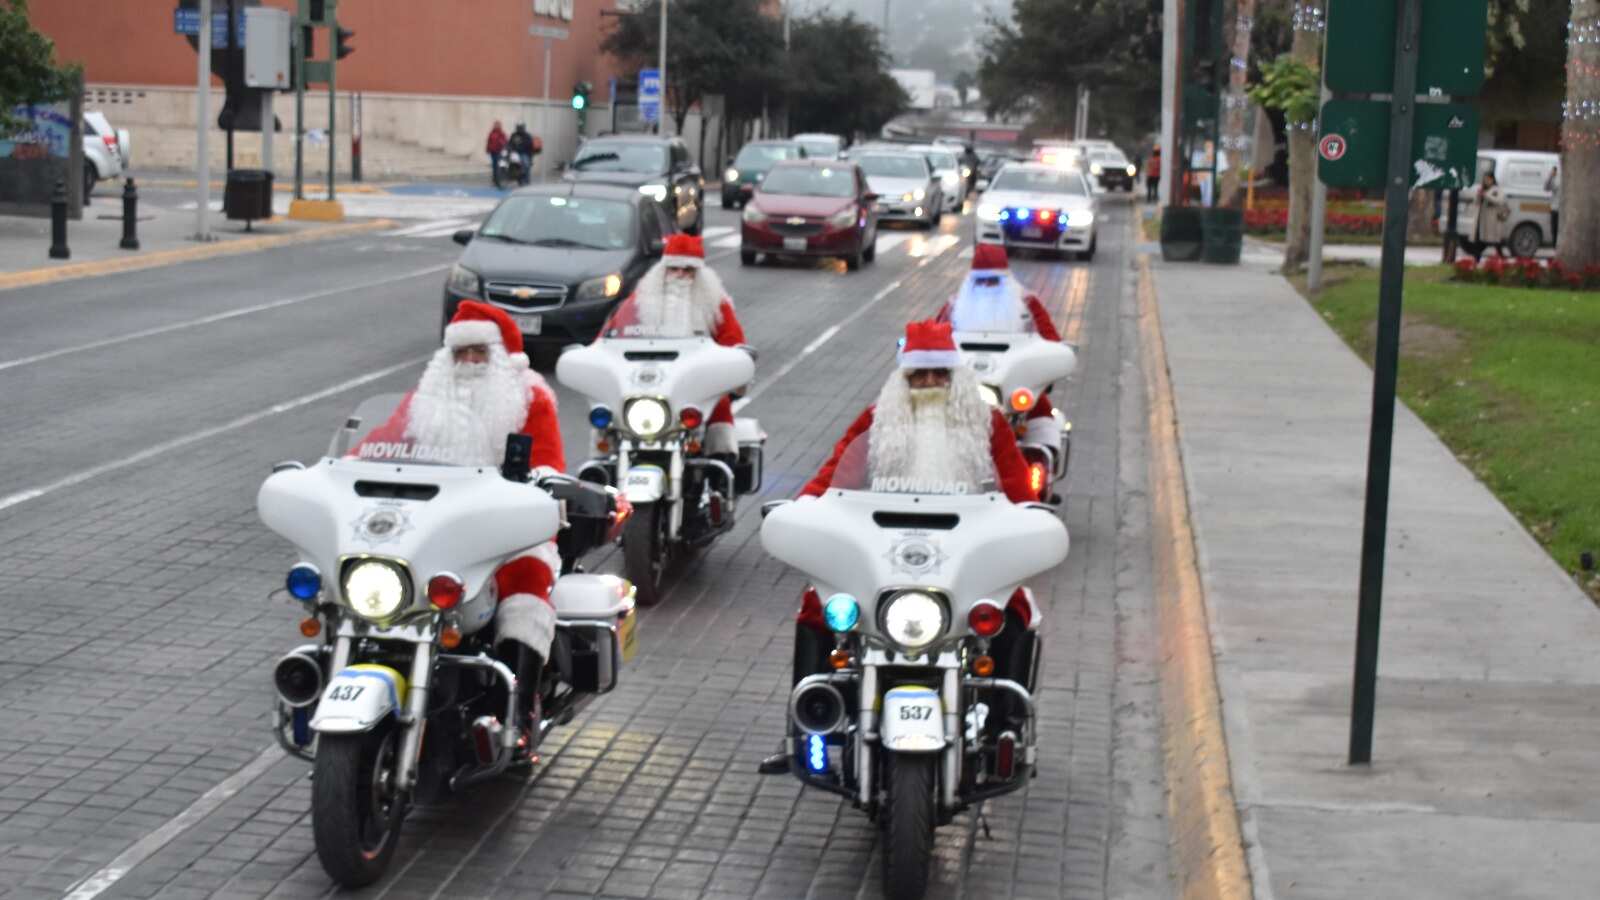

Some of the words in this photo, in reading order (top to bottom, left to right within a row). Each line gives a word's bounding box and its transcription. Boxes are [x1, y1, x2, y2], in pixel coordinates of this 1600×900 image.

[359, 442, 455, 460] MOVILIDAD
[871, 476, 968, 495] MOVILIDAD
[328, 684, 366, 701] 437
[900, 705, 933, 721] 537
